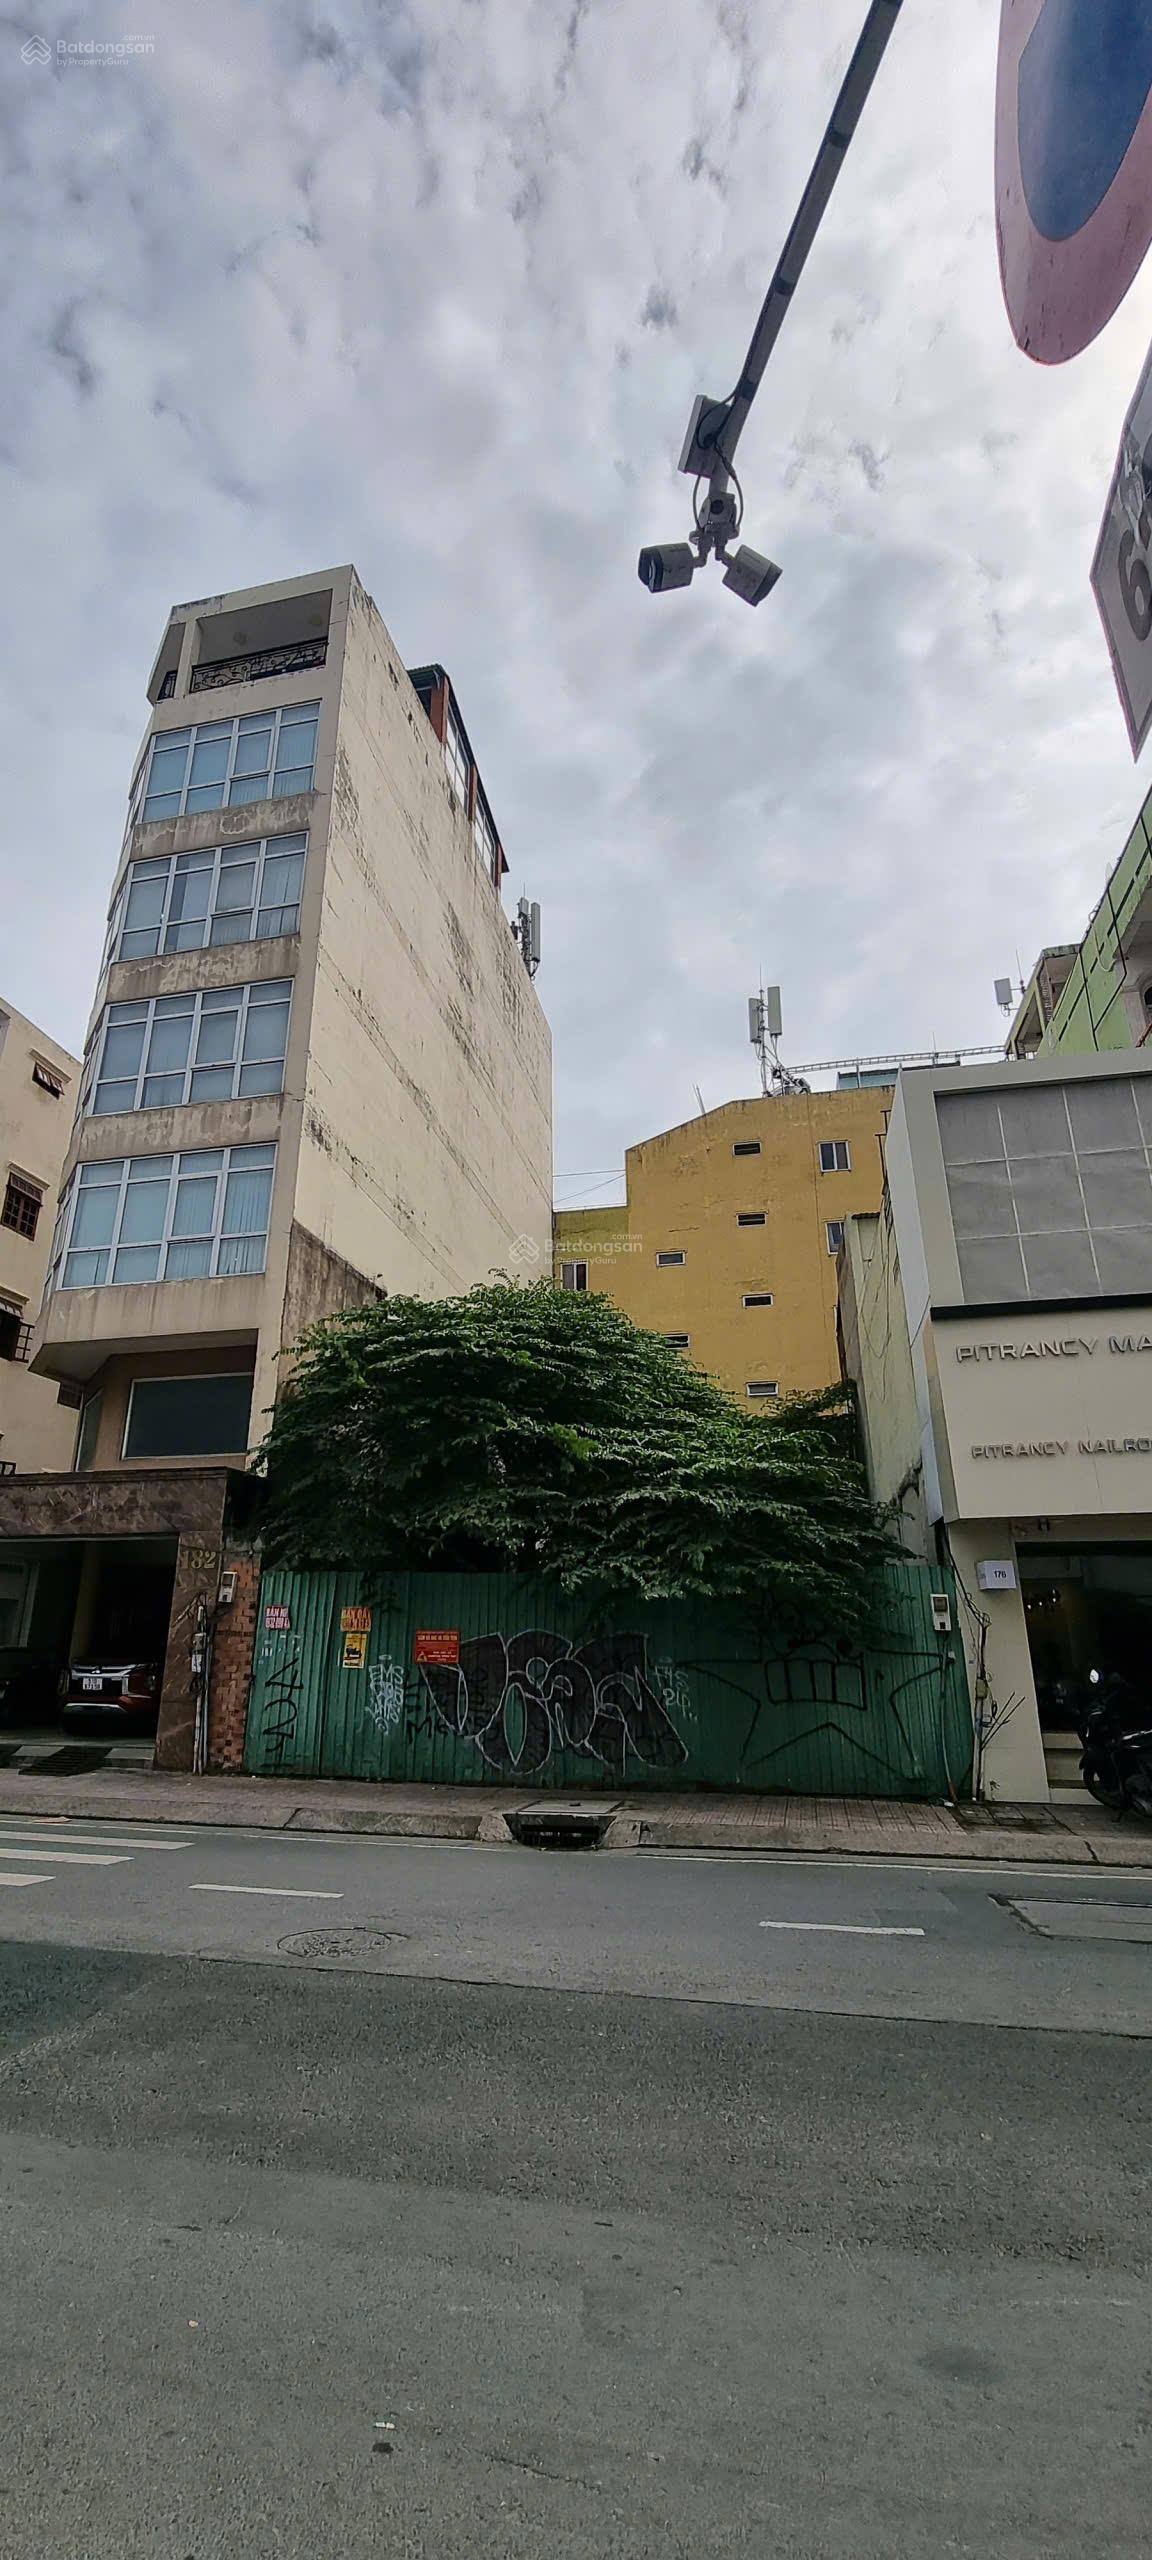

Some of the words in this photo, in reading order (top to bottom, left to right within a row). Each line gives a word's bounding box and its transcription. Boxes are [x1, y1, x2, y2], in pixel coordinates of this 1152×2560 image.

[956, 1336, 1098, 1363] PITRANCY
[971, 1440, 1069, 1459] PITRANCY
[1078, 1438, 1152, 1454] NAILRO
[180, 1550, 217, 1569] 182
